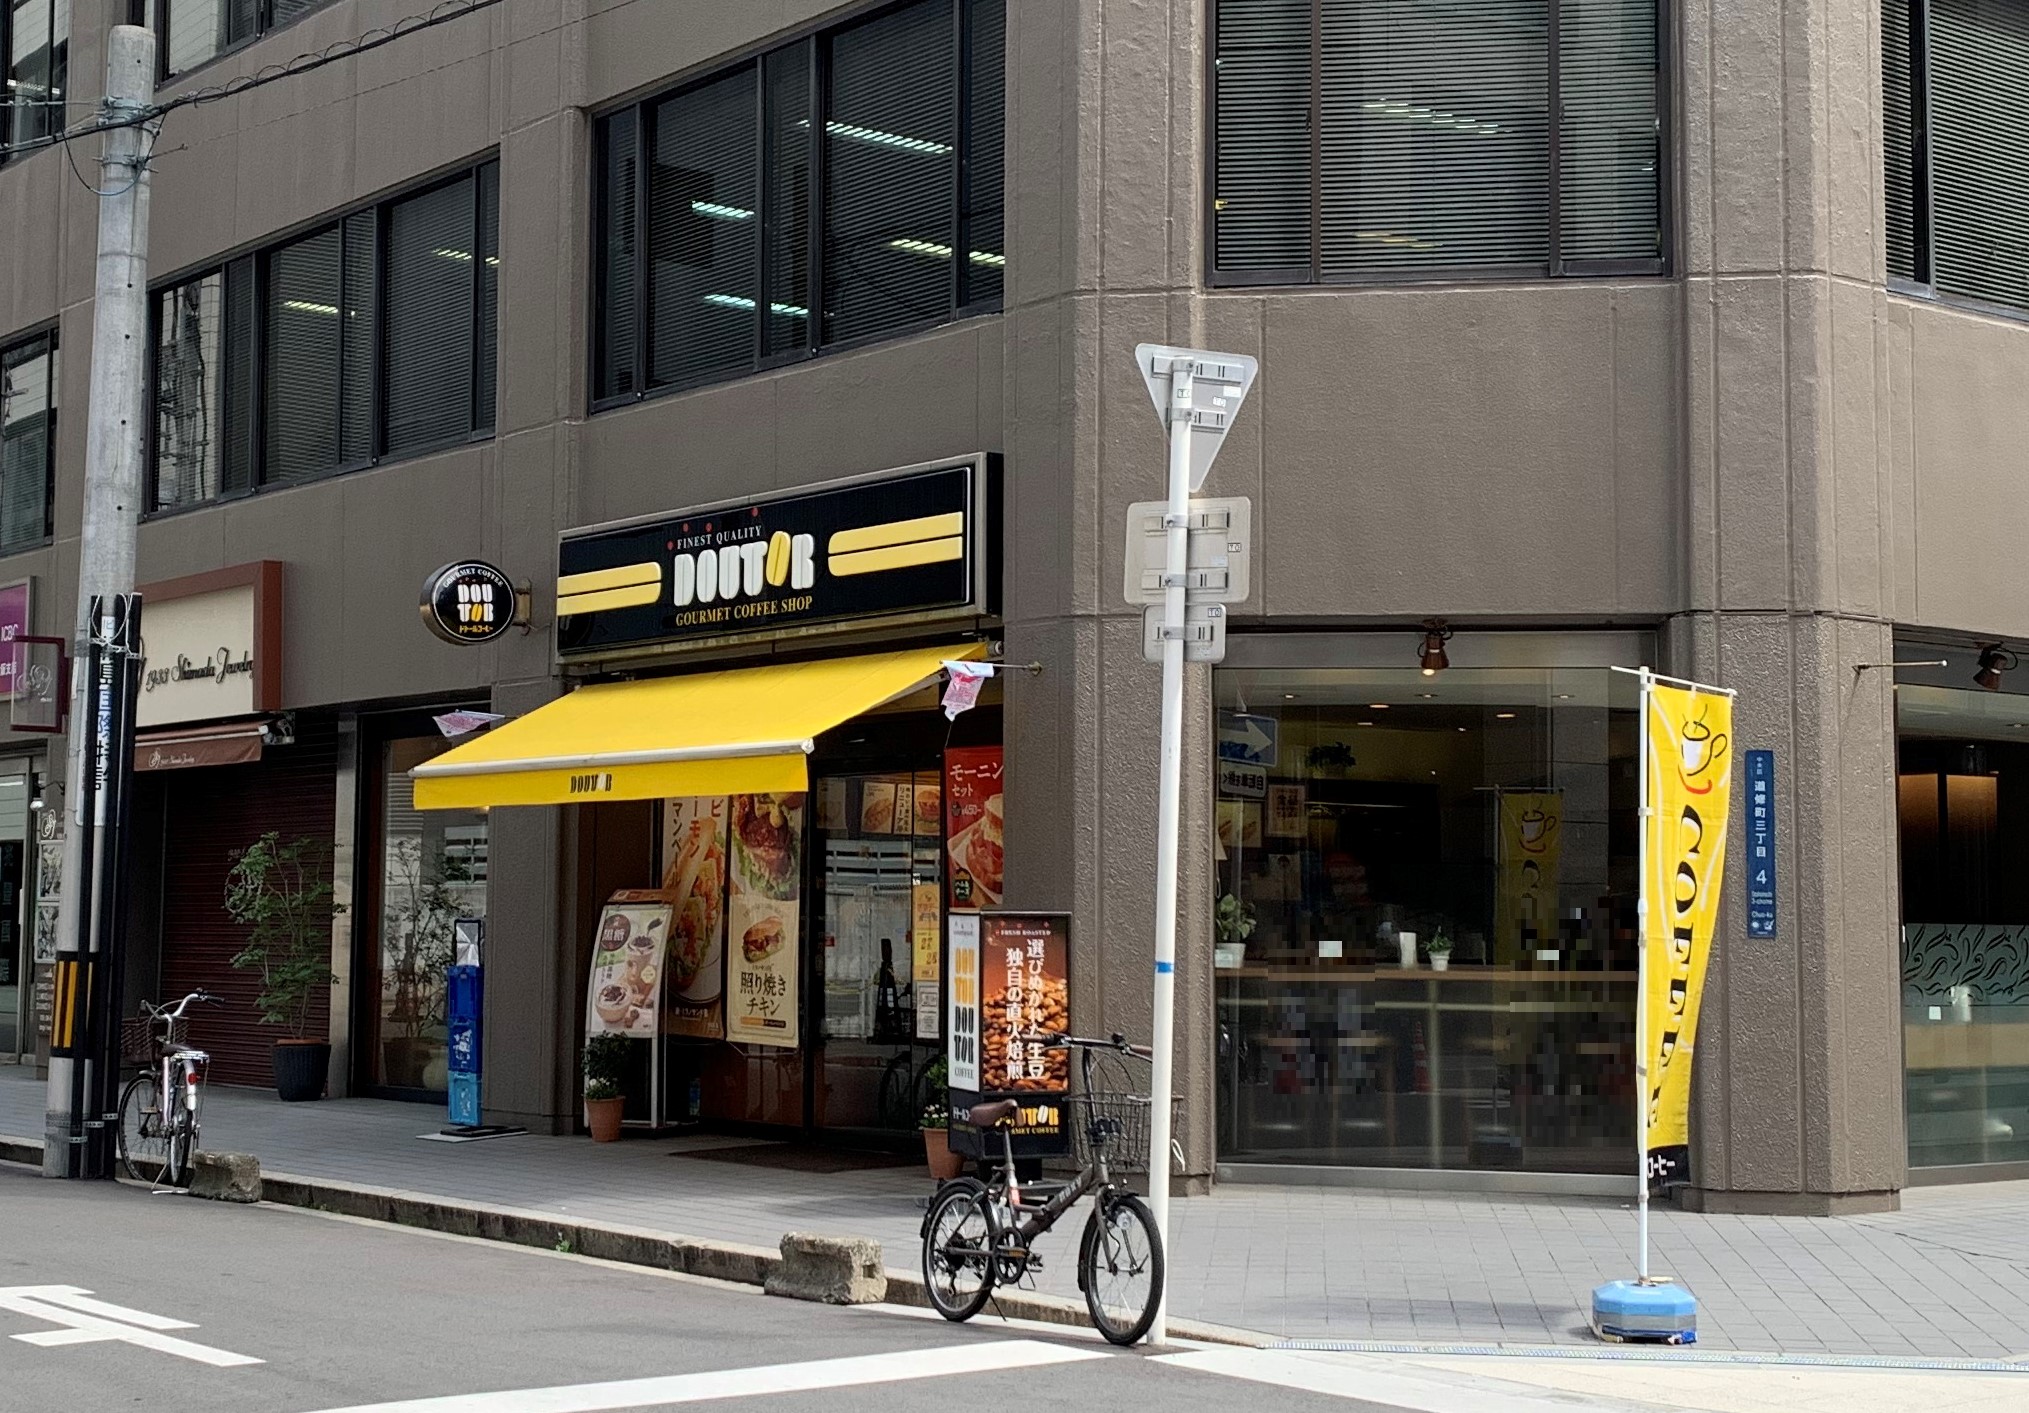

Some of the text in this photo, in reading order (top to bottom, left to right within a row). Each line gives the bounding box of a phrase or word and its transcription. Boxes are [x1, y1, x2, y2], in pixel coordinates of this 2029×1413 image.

[677, 525, 762, 550] FINEST QUALITY
[443, 568, 503, 588] GOURMET COFFEE
[674, 531, 814, 606] DOUTOR
[458, 583, 493, 603] DOU
[457, 603, 494, 622] TOR
[676, 595, 813, 626] GOURMET COFFEE SHOP
[570, 773, 612, 793] DOUTOR
[952, 783, 974, 797] セット
[1756, 869, 1767, 884] 4
[1646, 804, 1703, 1129] COFFEE
[740, 972, 786, 997] 照り焼き
[746, 997, 780, 1016] チキン
[1006, 947, 1025, 1080] 独自の直火焙煎
[954, 1066, 975, 1080] COFFEE
[1032, 1126, 1059, 1134] COFFEE
